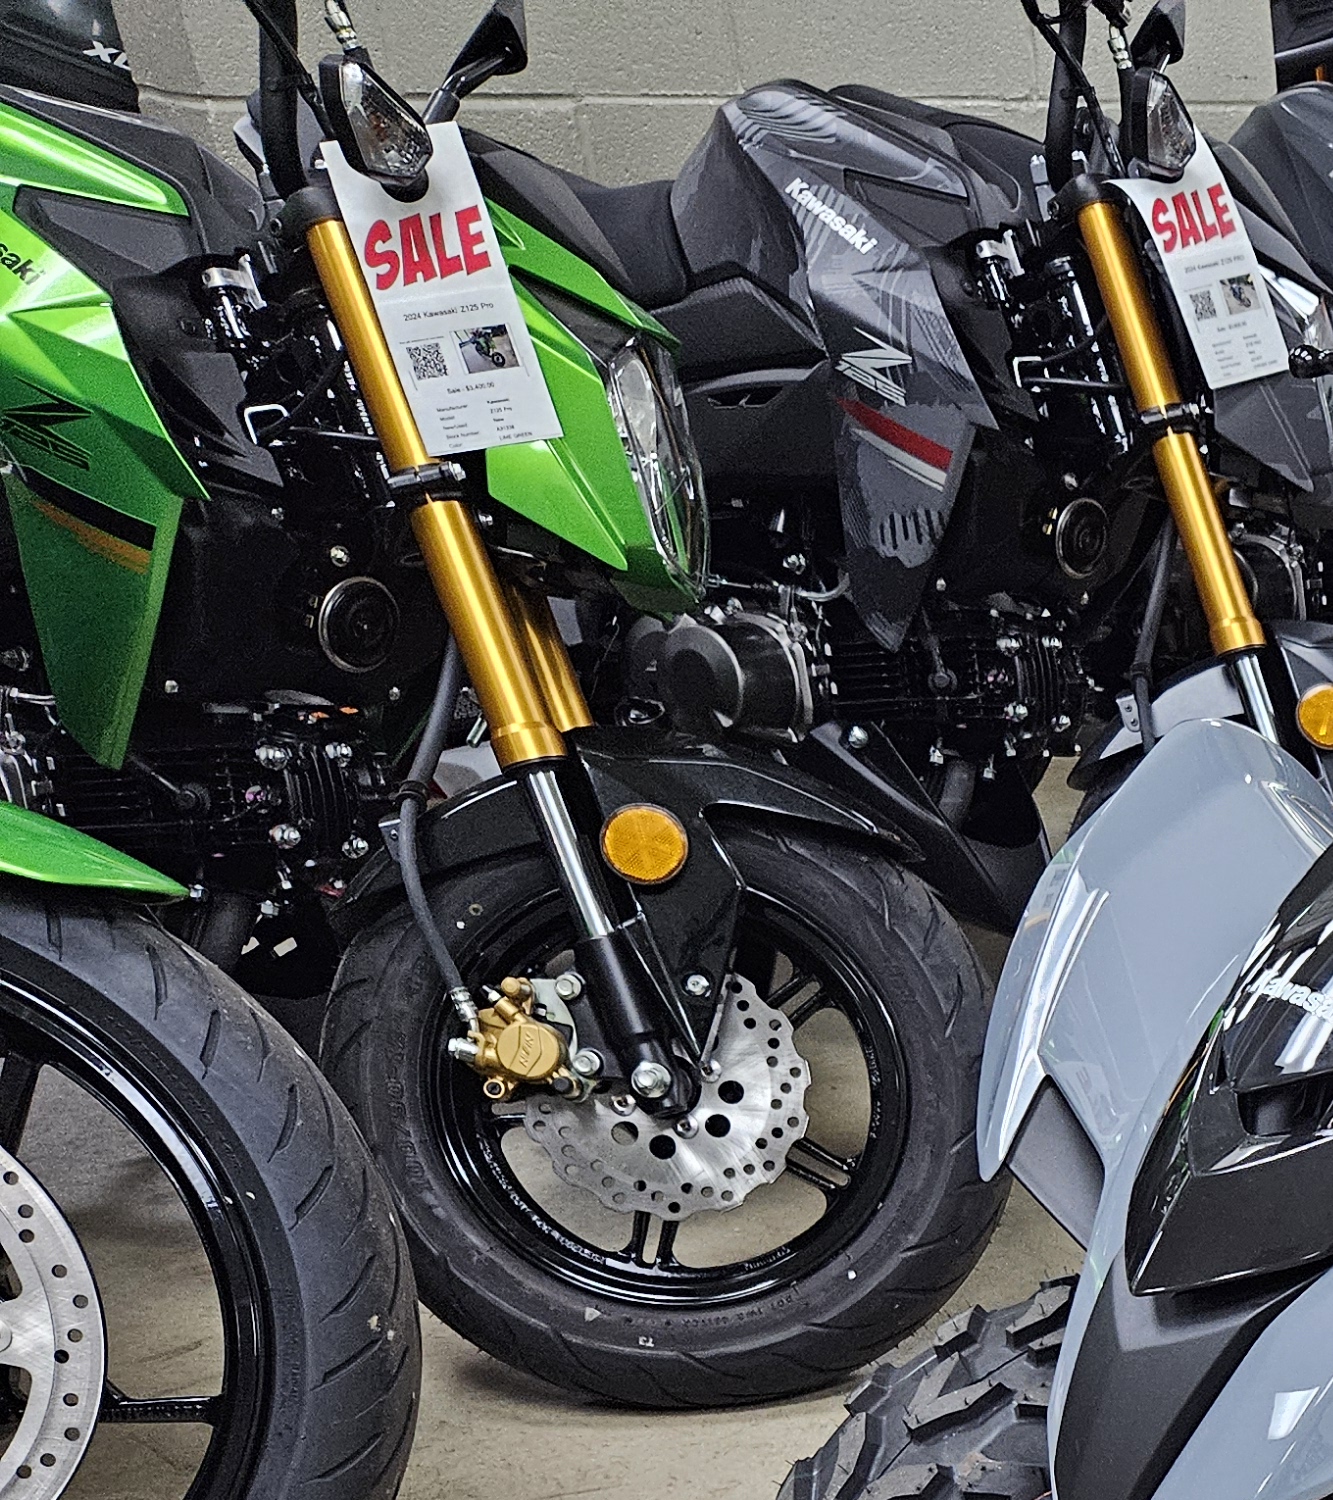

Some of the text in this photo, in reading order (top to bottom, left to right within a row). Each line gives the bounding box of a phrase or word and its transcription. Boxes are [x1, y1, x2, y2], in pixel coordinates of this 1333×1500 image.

[364, 204, 491, 290] SALE
[785, 177, 878, 254] Kawasaki
[1151, 182, 1236, 253] SALE
[423, 307, 458, 318] Kawasaki
[460, 304, 479, 313] Z125
